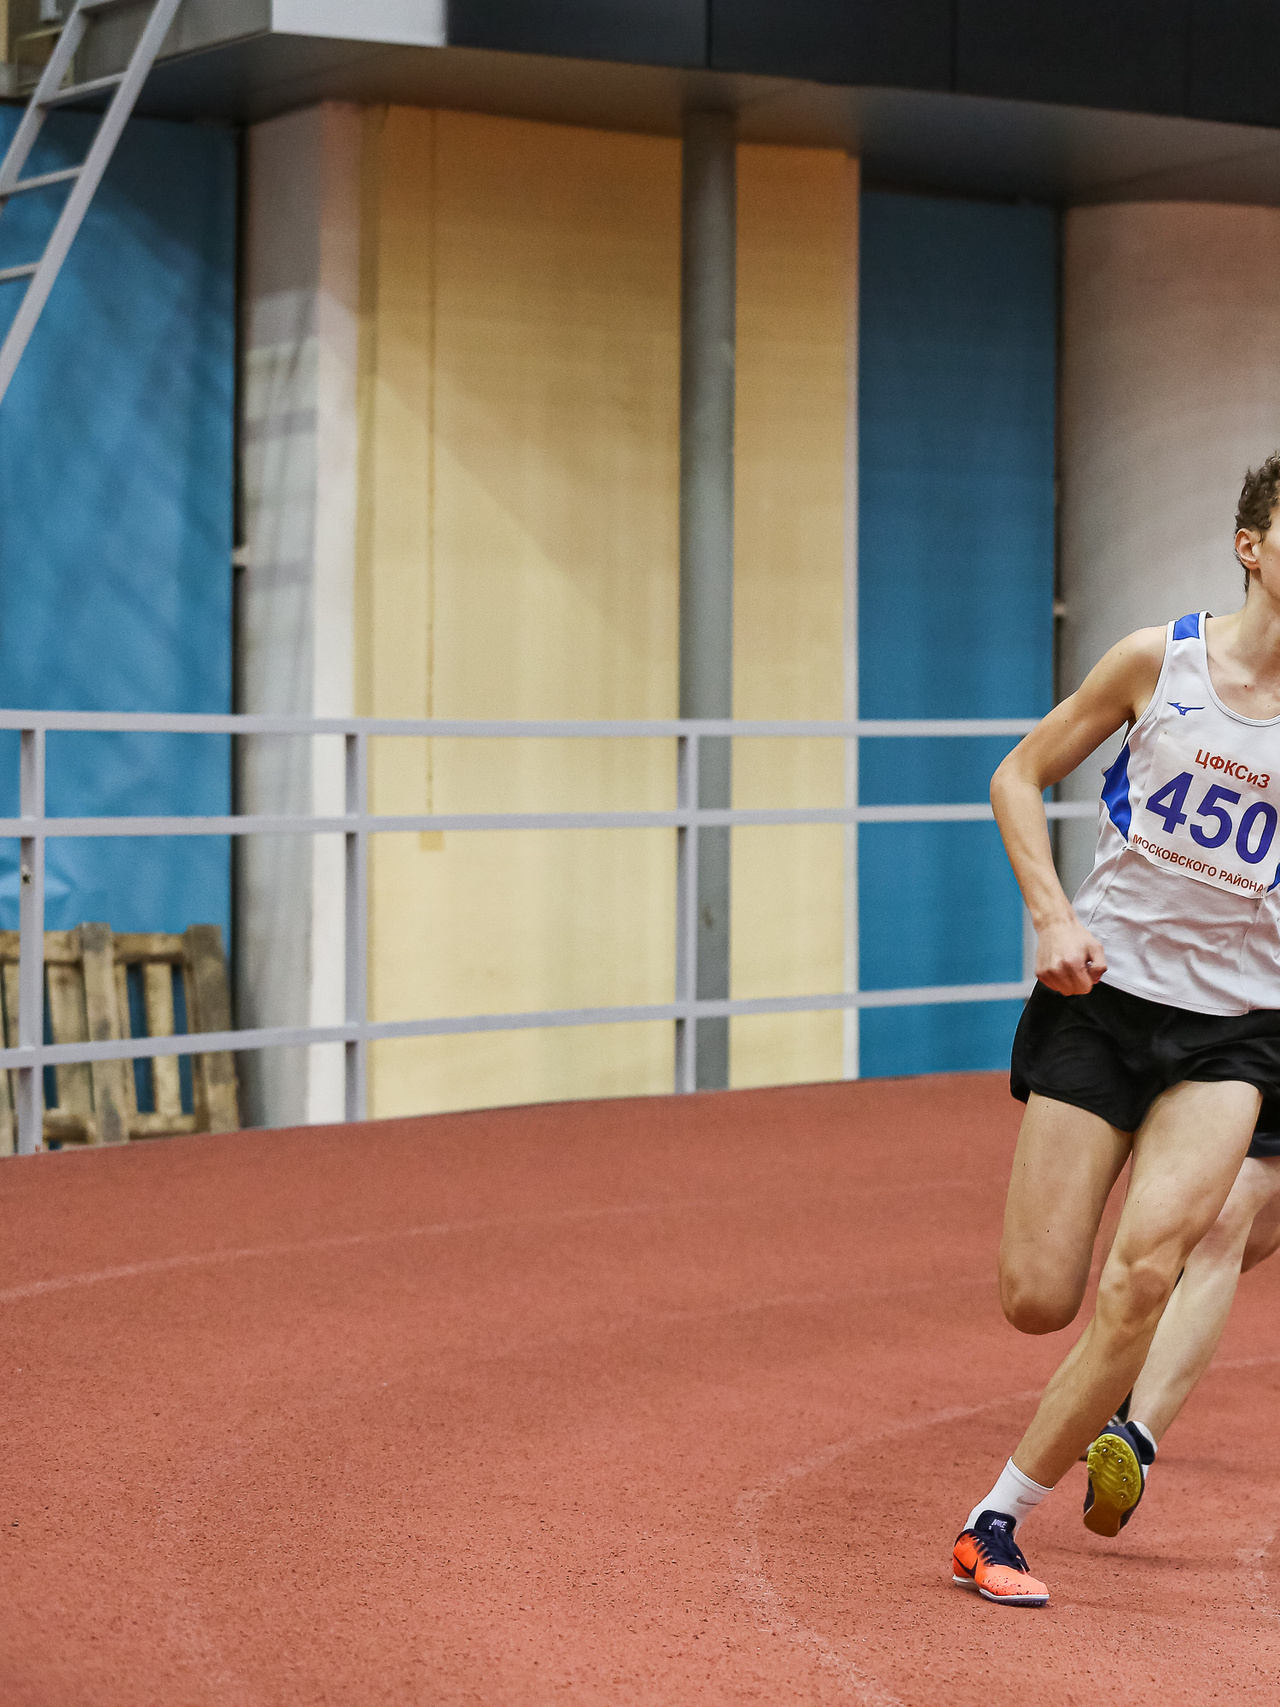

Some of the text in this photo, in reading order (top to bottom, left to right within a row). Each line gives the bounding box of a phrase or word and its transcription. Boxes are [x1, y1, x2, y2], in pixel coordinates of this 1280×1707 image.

[1145, 771, 1278, 865] 450
[1132, 833, 1265, 893] МОСКОВСКОГО РАЙОНА
